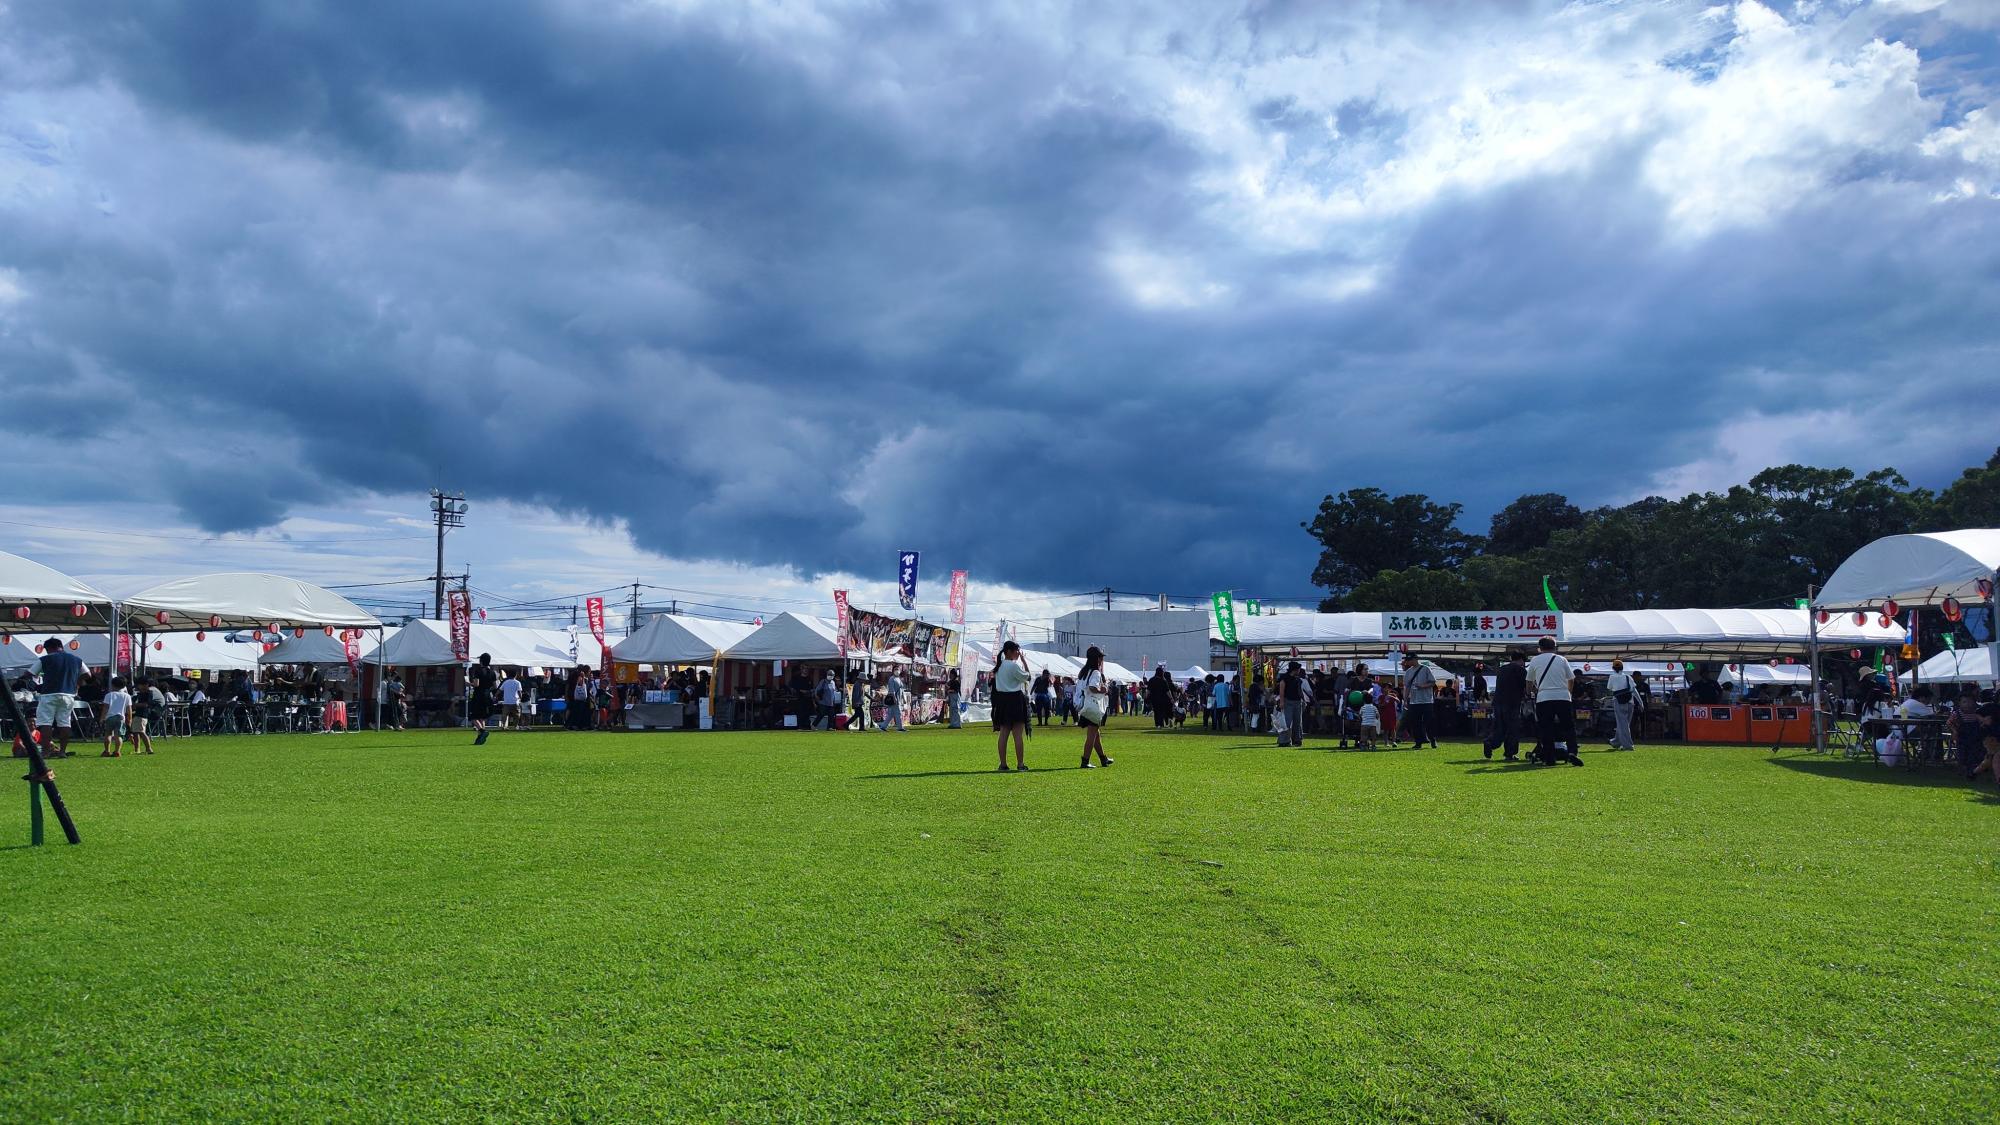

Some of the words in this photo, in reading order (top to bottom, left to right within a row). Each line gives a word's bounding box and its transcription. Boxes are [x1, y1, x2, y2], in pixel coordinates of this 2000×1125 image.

[1389, 615, 1557, 631] ふれあい農業まつり広場
